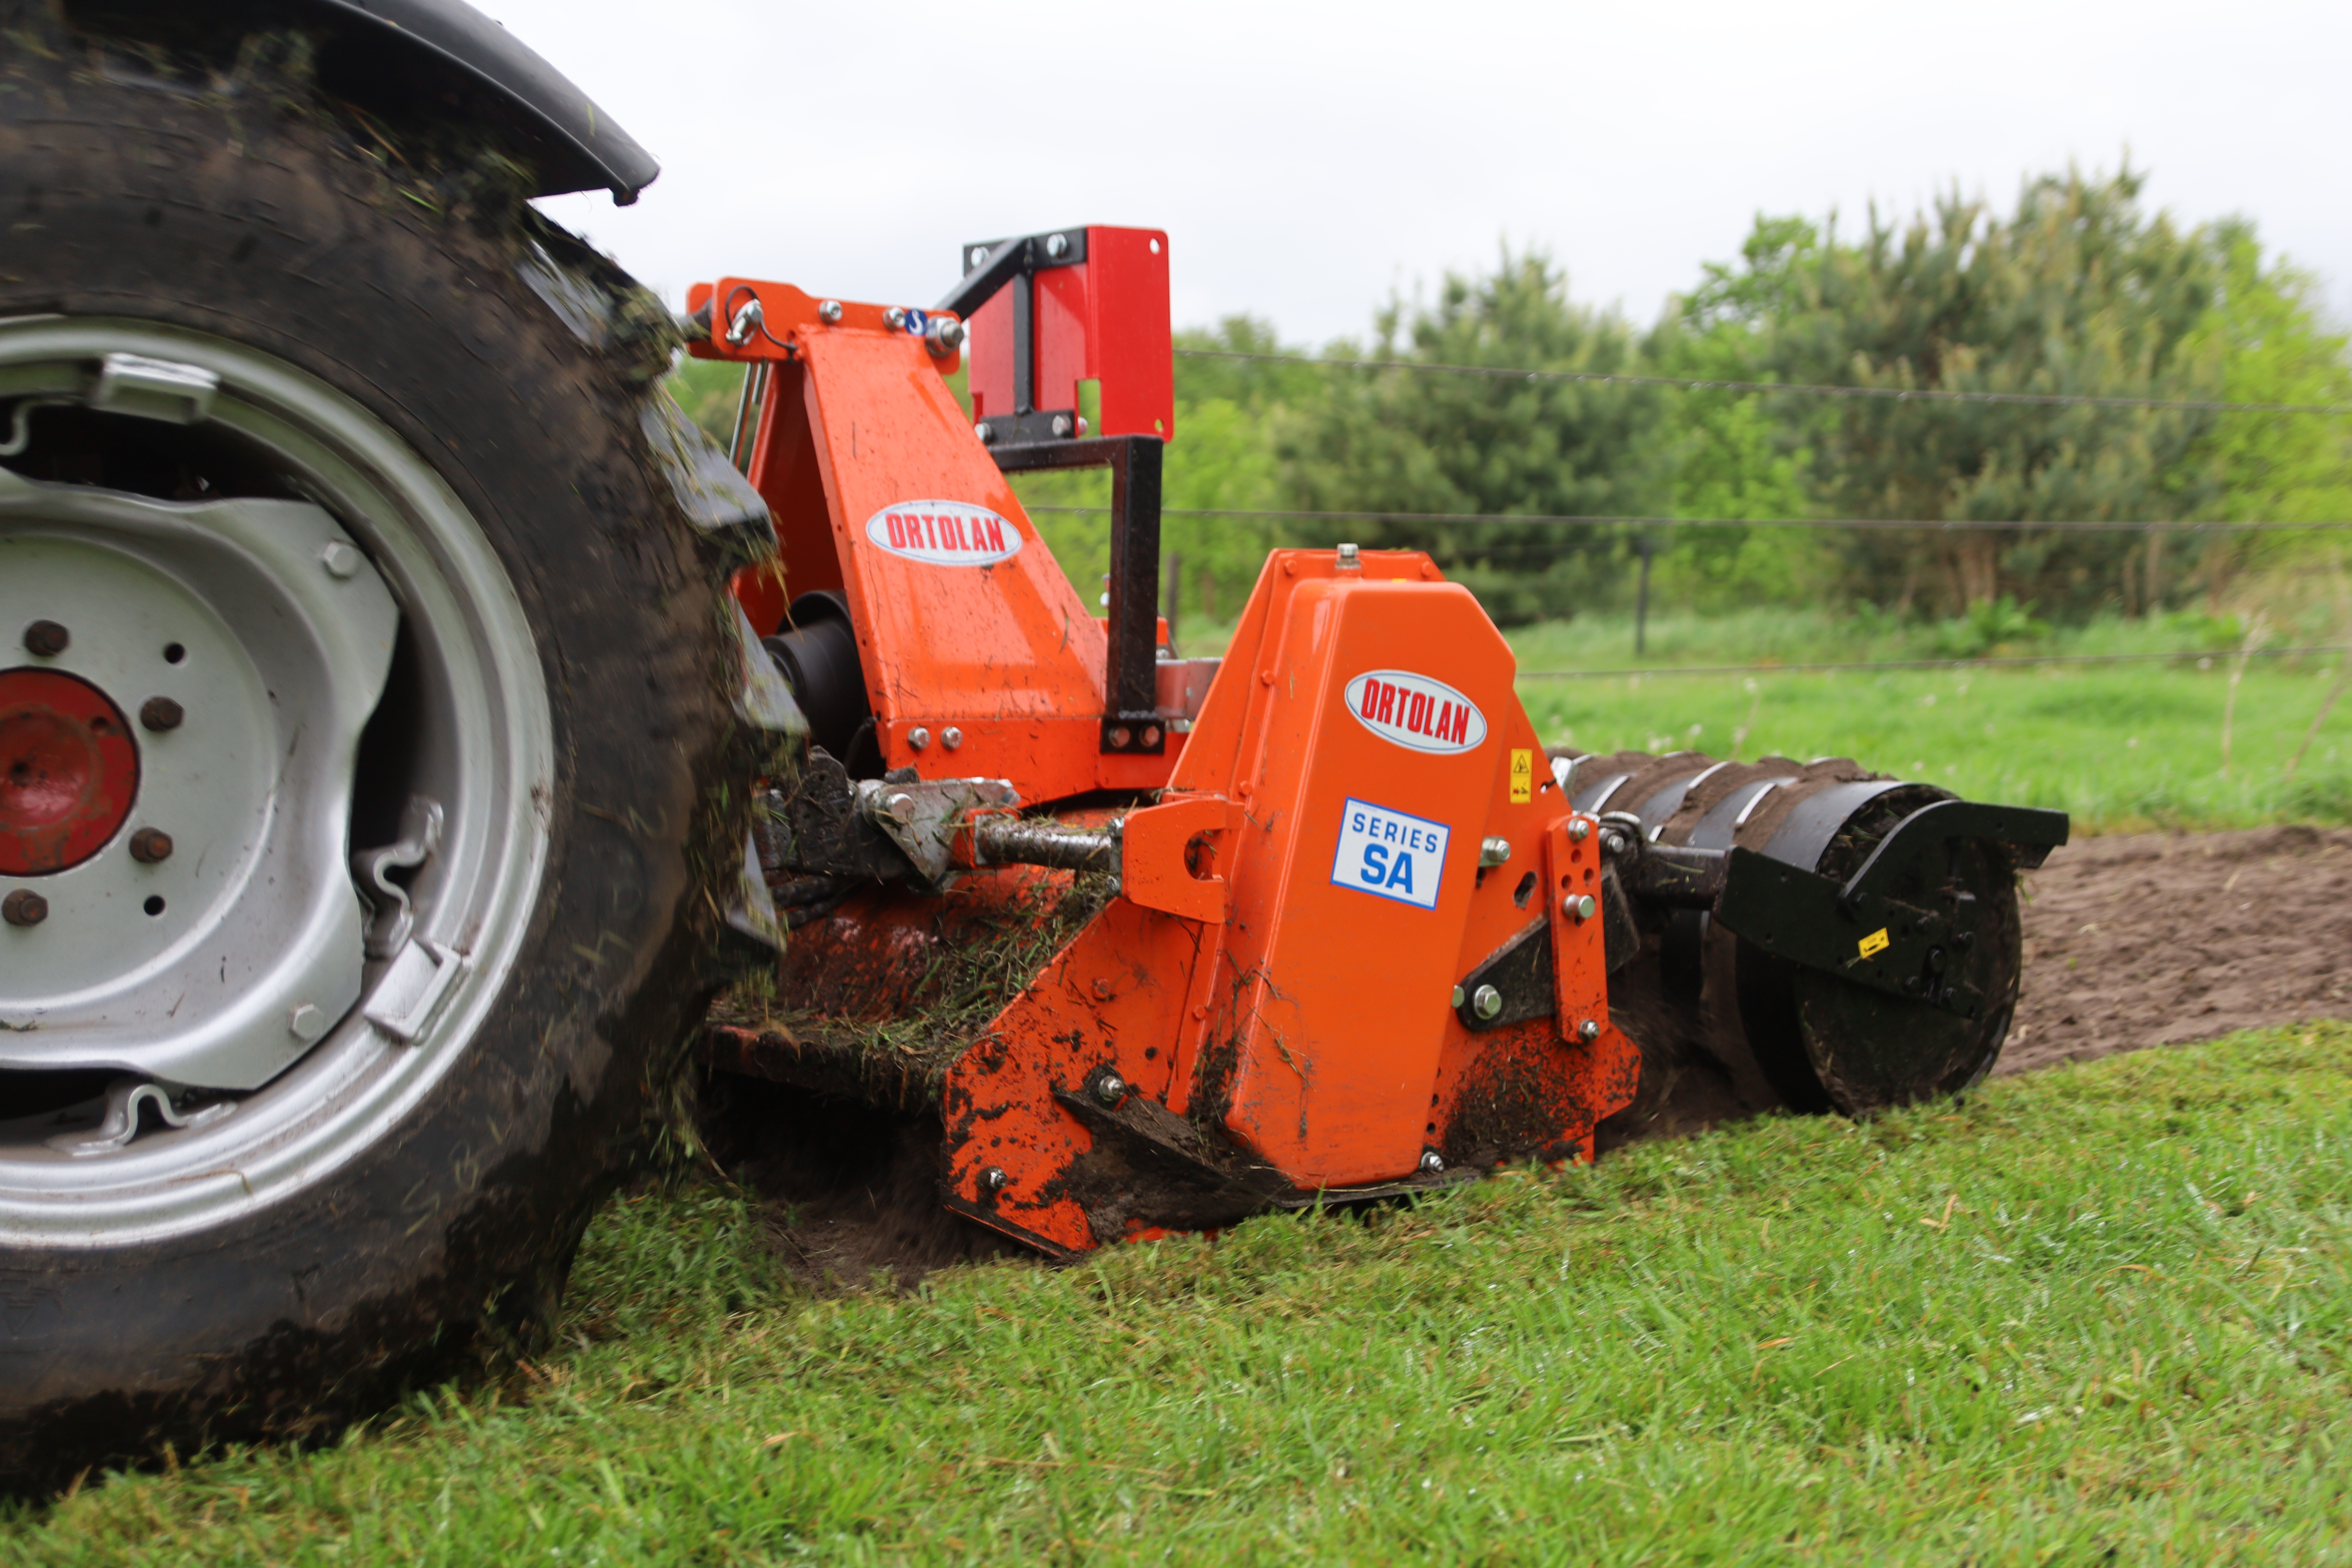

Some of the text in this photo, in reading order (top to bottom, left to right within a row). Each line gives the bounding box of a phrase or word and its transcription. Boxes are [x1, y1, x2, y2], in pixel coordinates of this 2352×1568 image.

[885, 514, 1006, 552] ORTOLAN
[1361, 678, 1470, 745] ORTOLAN
[1352, 812, 1438, 853] SERIES
[1360, 843, 1413, 894] SA
